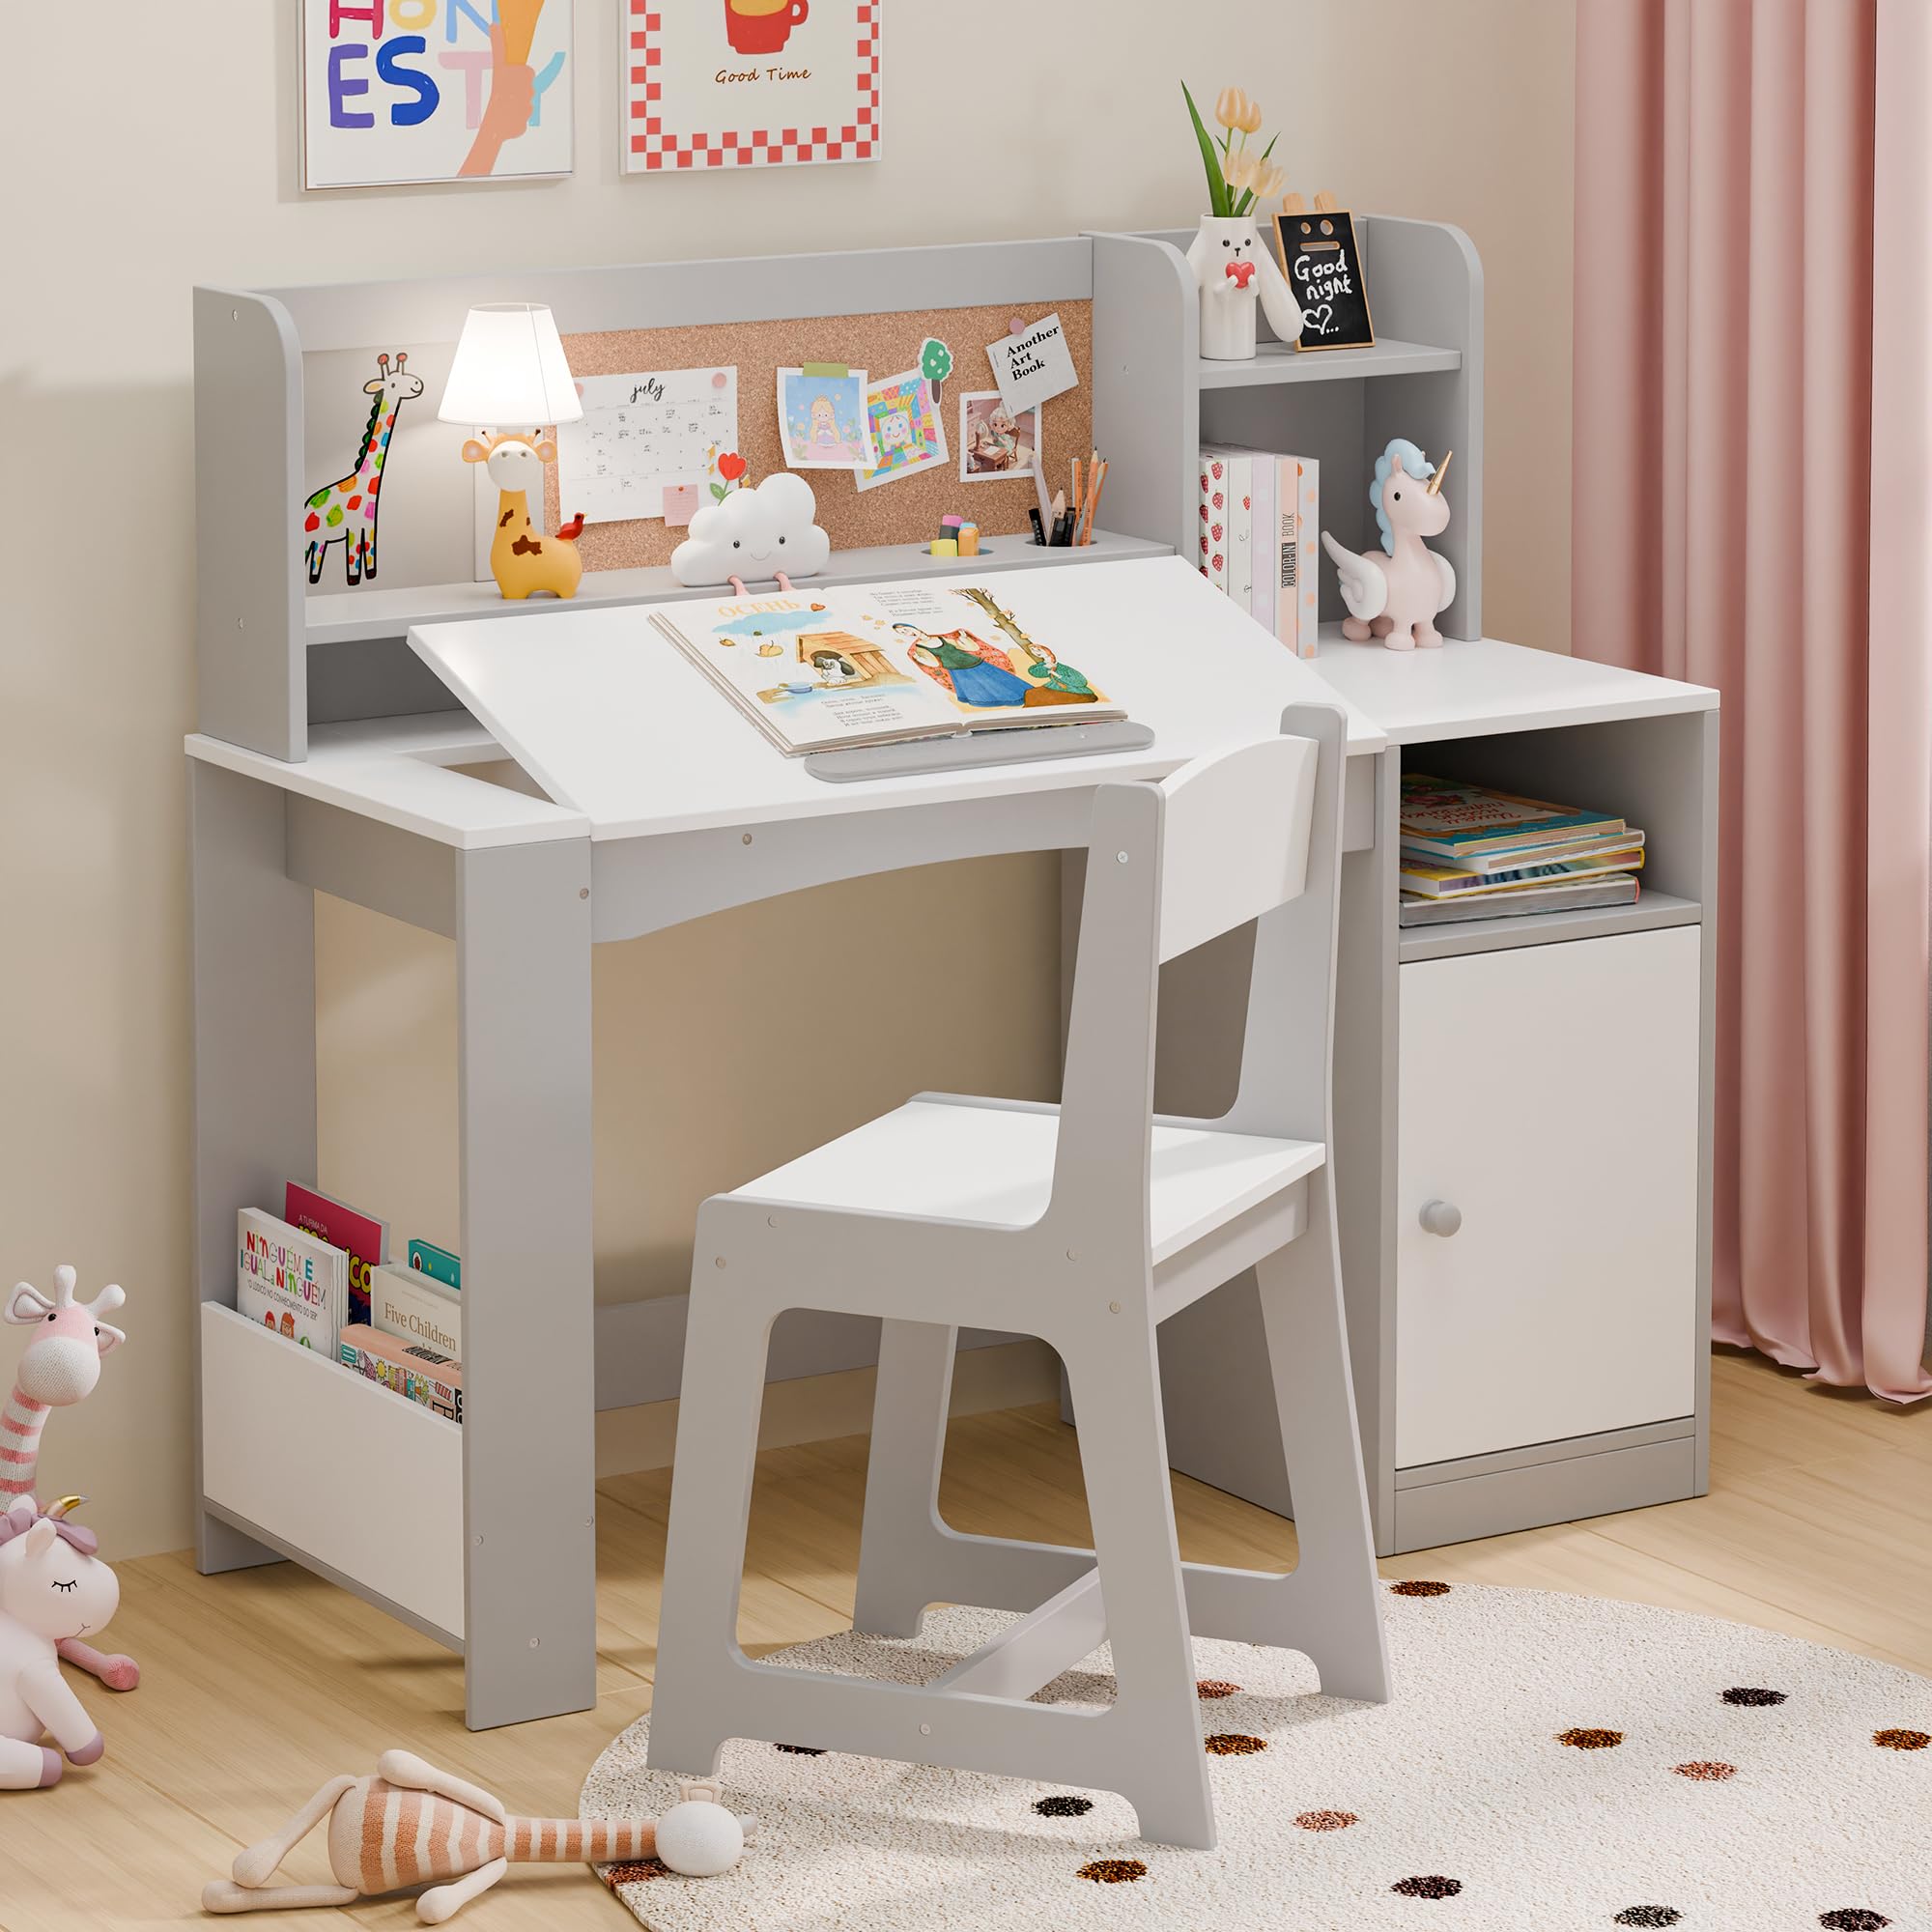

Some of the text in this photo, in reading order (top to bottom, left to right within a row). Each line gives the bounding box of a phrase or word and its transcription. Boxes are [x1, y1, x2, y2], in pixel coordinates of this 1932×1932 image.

[715, 68, 811, 84] Good Time
[1294, 248, 1348, 281] Good
[1306, 274, 1352, 300] night
[1007, 327, 1060, 357] Another
[1010, 352, 1033, 369] Art
[1012, 359, 1046, 382] Book
[630, 378, 666, 404] july
[1282, 512, 1295, 537] BOOK
[718, 599, 801, 618] ОСЕНЬ
[320, 1224, 328, 1236] DA
[241, 1248, 270, 1283] IGUAL
[305, 1257, 314, 1282] É
[384, 1301, 457, 1352] Five Children
